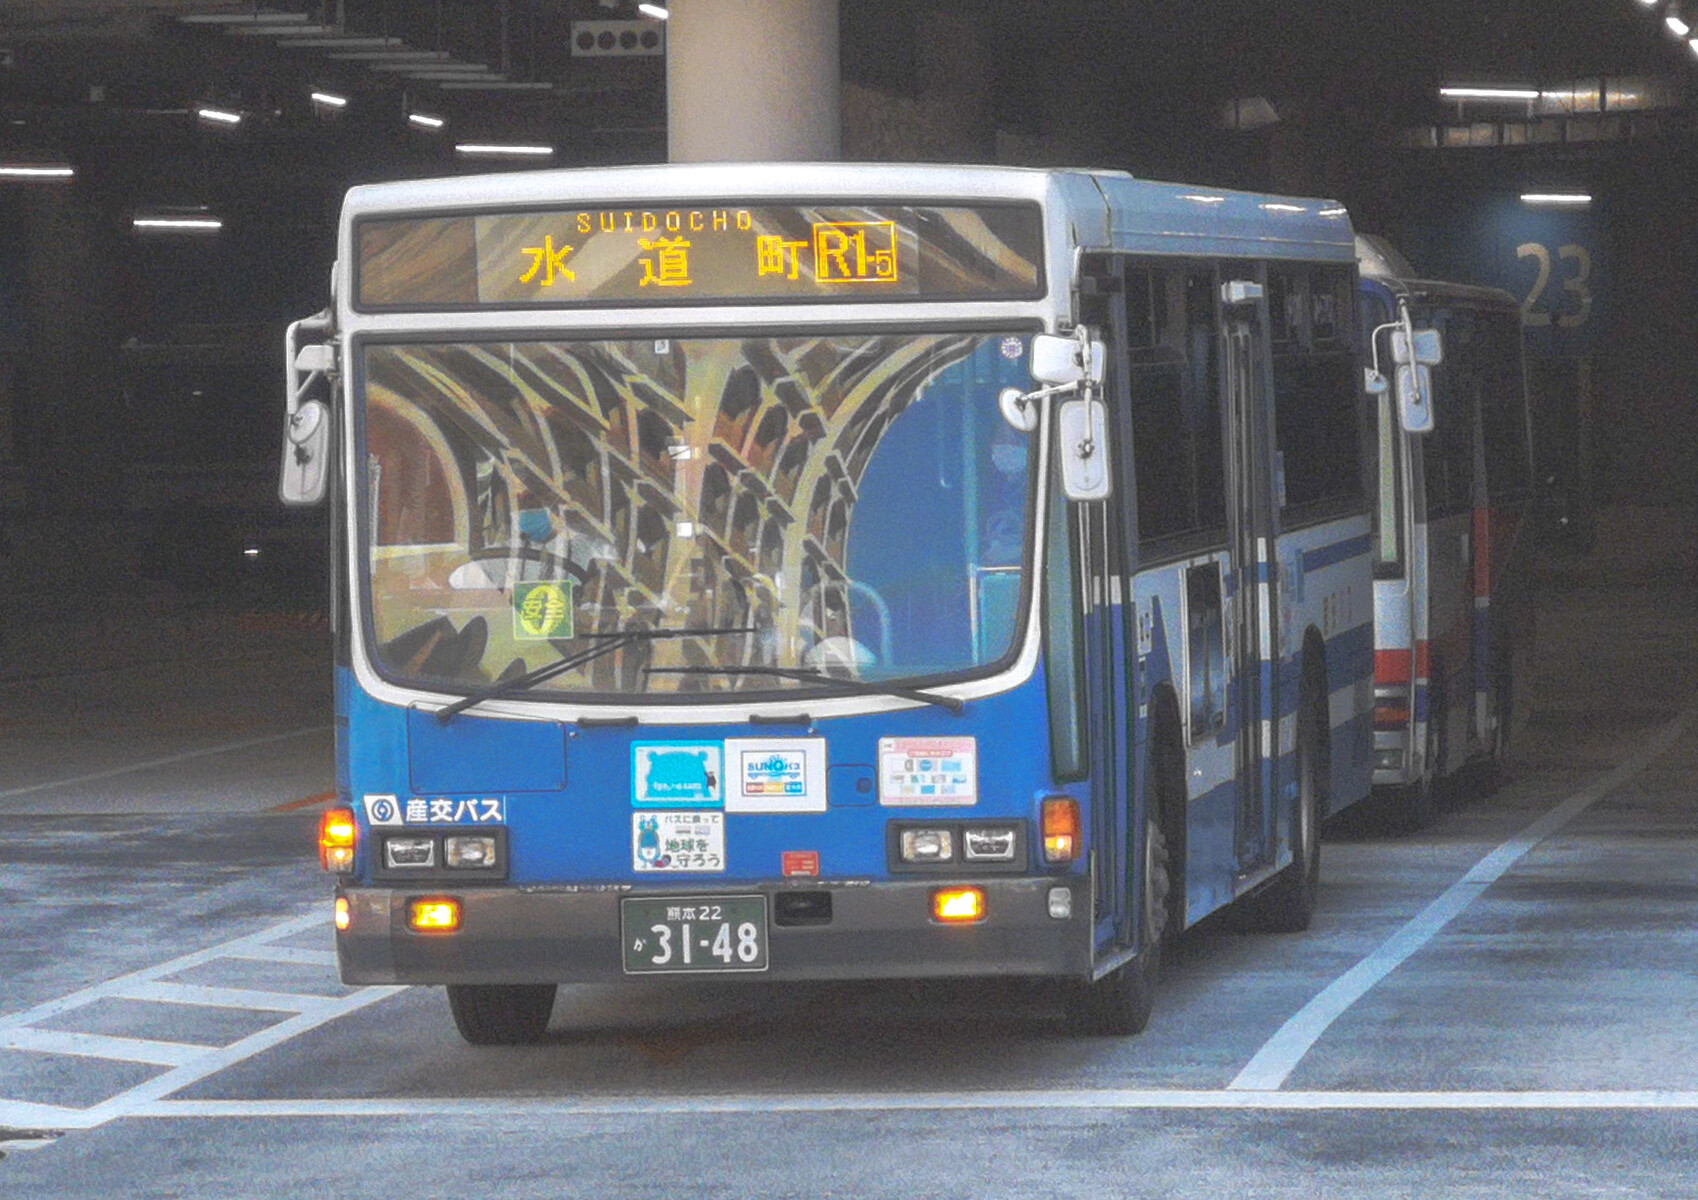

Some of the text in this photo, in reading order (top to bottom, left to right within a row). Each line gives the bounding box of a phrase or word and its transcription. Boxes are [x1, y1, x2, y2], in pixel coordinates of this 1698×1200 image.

[577, 210, 753, 233] SUIDOCHO
[818, 229, 892, 277] R1-5
[1517, 242, 1592, 327] 23
[406, 799, 502, 822] 産交バス
[665, 838, 709, 852] 地球を
[676, 853, 720, 867] 守ろう
[651, 922, 758, 964] 31-48
